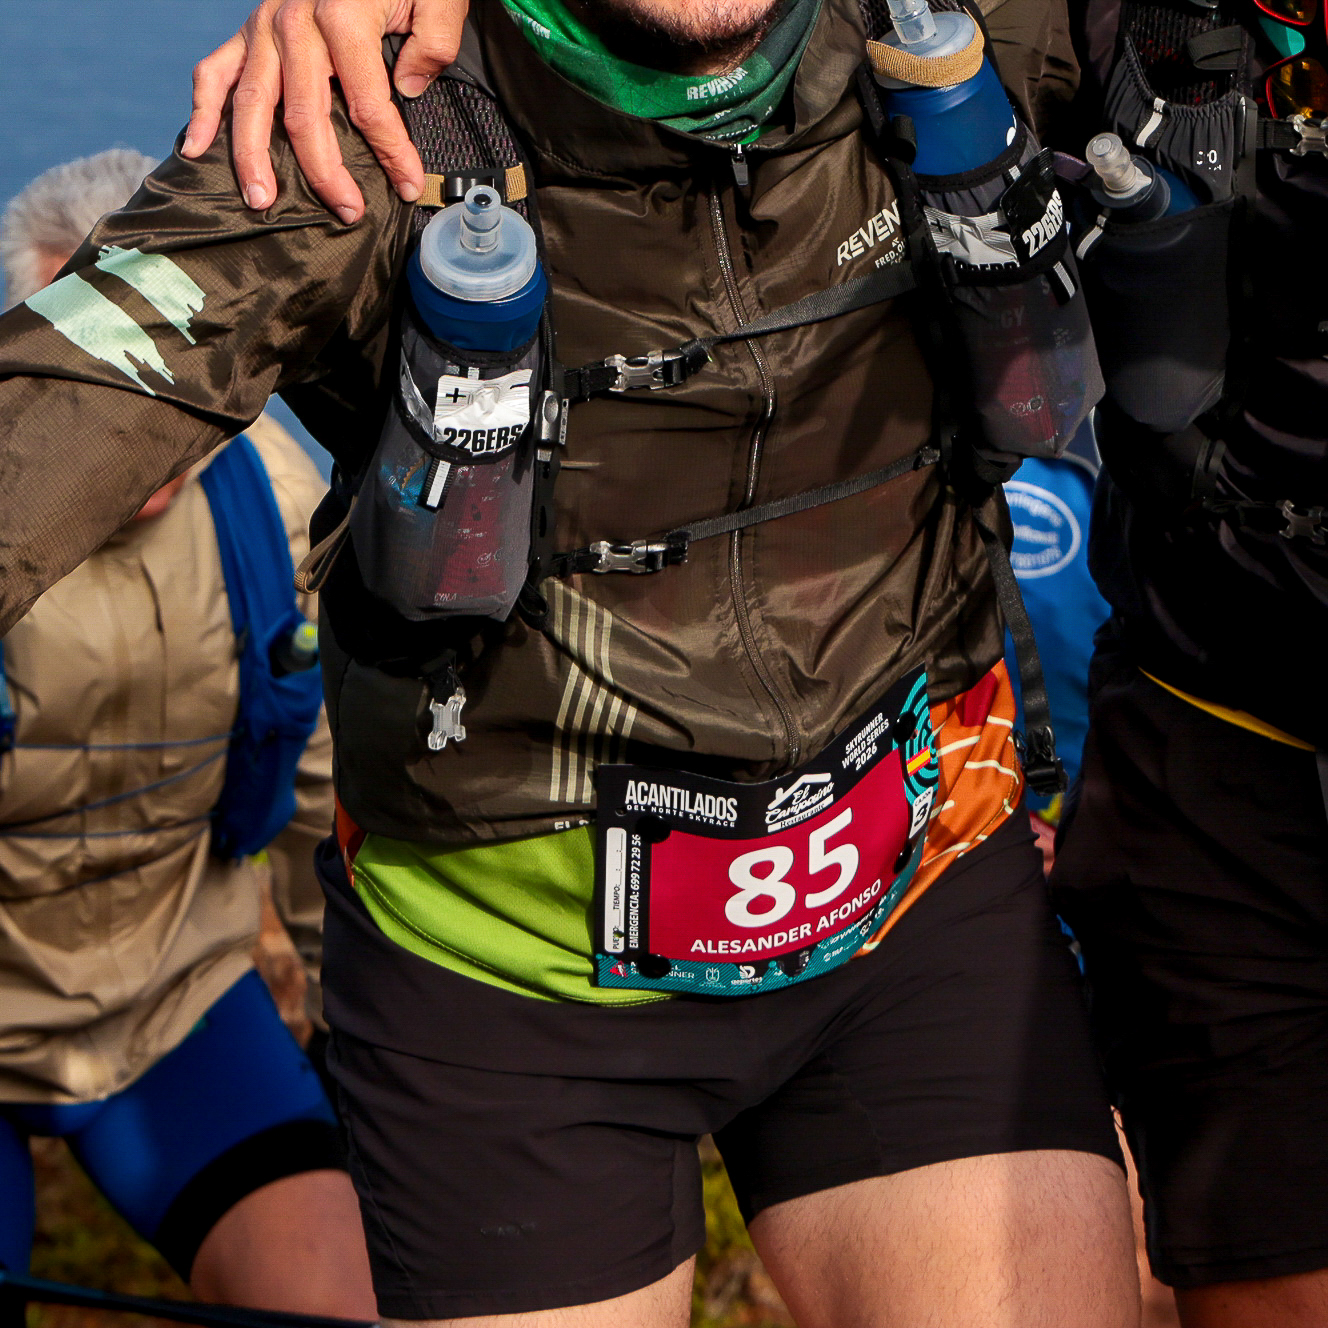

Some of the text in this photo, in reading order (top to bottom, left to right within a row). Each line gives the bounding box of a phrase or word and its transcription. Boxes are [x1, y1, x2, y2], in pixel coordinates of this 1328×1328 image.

[837, 198, 901, 266] REVEN
[1021, 188, 1063, 258] 226ERS
[443, 424, 524, 453] 226ERS
[842, 718, 890, 769] WORLD SERIES
[845, 712, 884, 754] SKYRUNNER
[855, 742, 878, 771] 2026
[625, 780, 738, 822] ACANTILADOS
[626, 804, 736, 828] DEL NORTE SKYRACE
[914, 802, 928, 827] 3
[724, 806, 859, 928] 85
[629, 834, 642, 949] EMERGENCIA: 699 72 29 56
[690, 878, 882, 954] ALESANDER AFONSO
